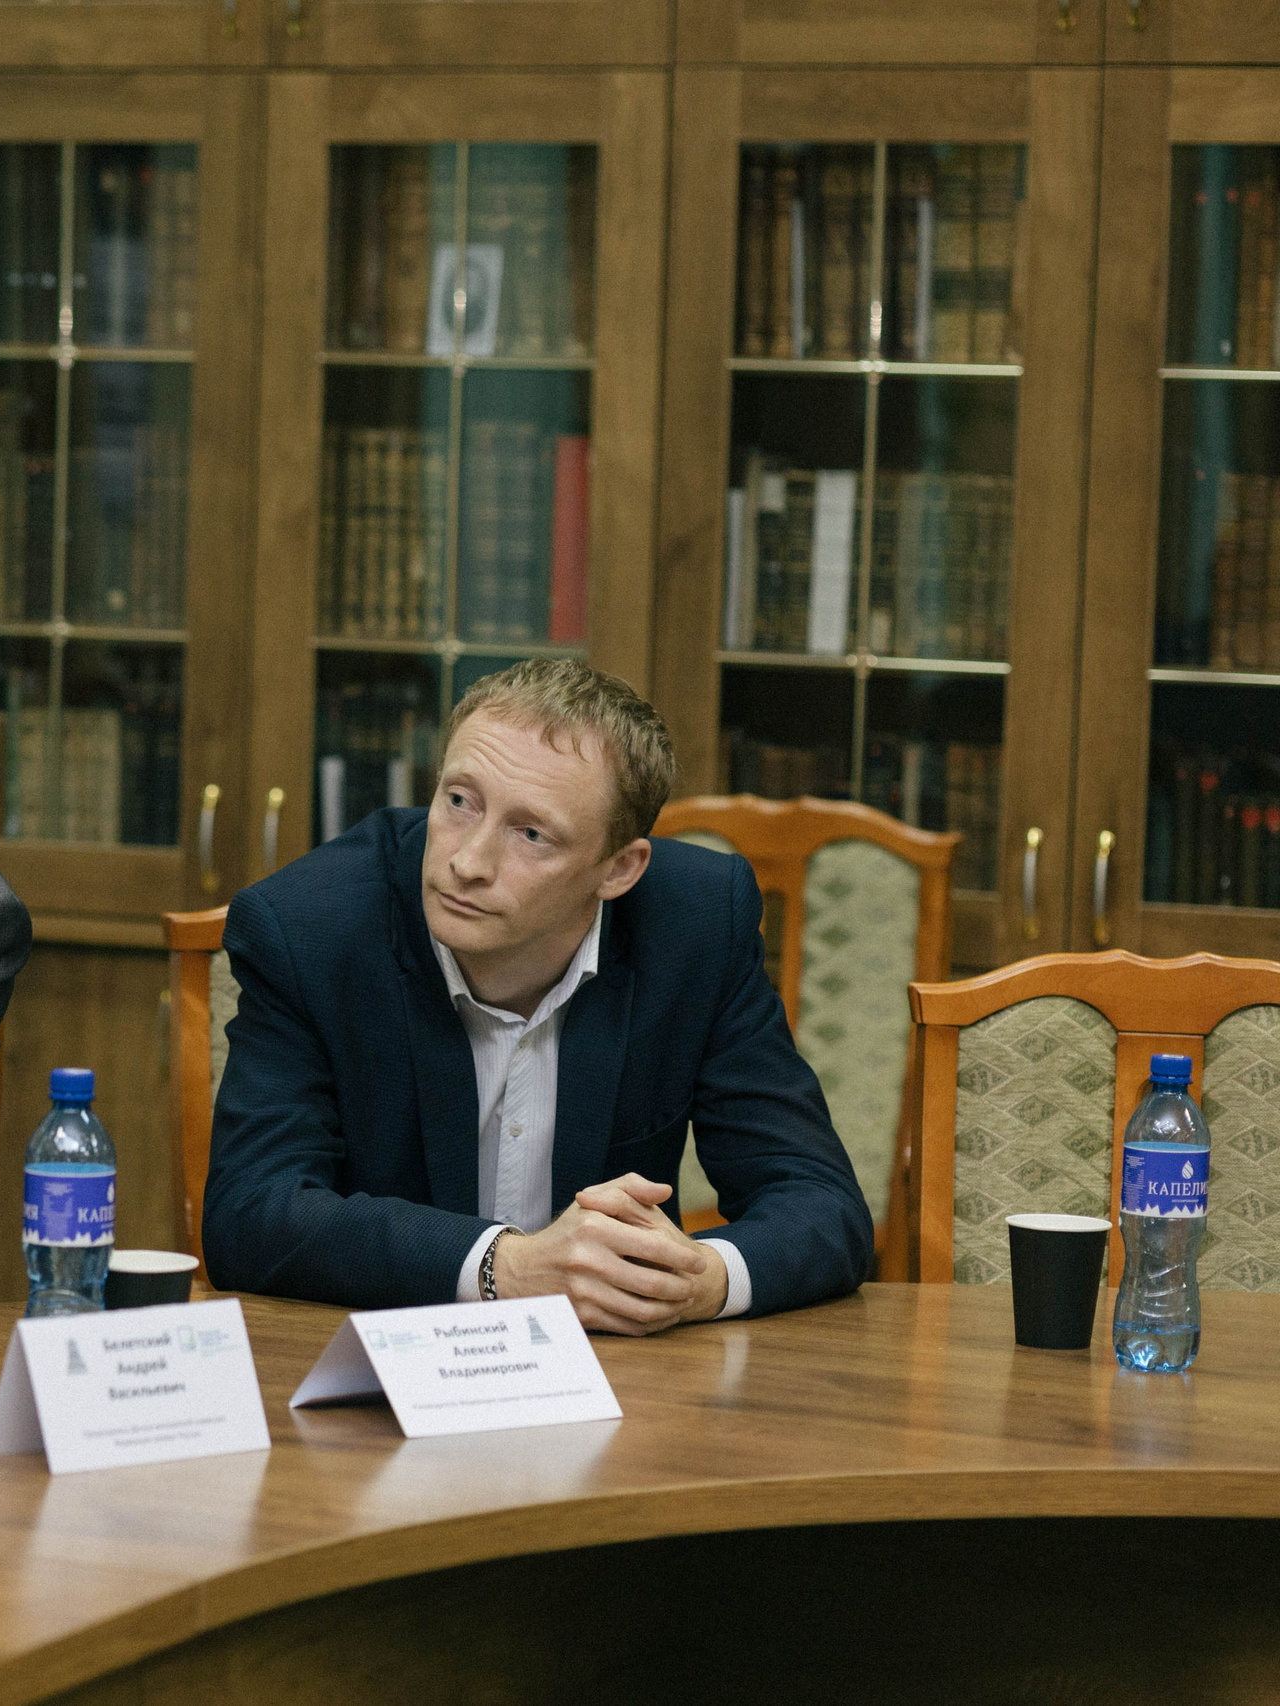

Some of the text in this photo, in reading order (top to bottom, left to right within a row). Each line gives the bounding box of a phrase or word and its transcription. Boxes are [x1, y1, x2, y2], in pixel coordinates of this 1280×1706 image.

[434, 1321, 508, 1338] Рыбинский
[454, 1342, 507, 1357] Алексей
[439, 1362, 539, 1379] Владимирович
